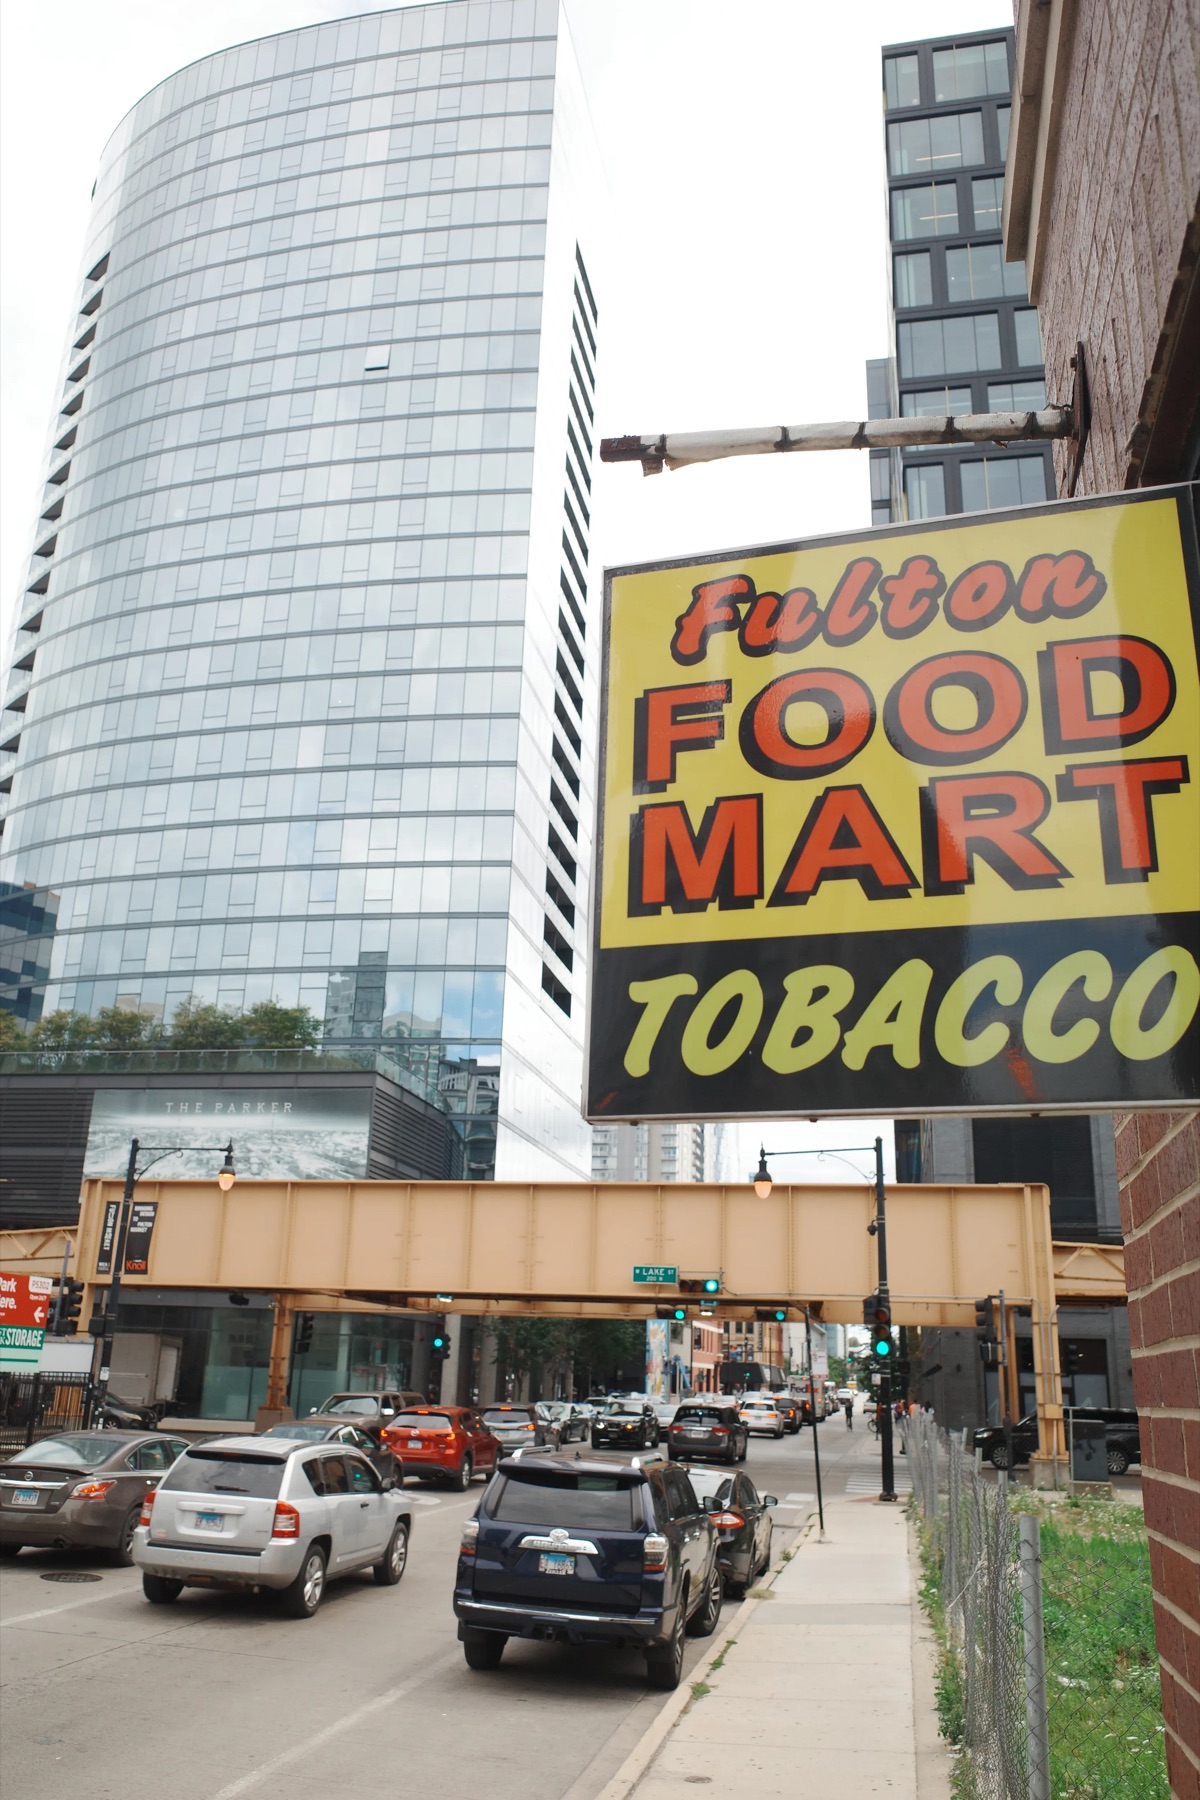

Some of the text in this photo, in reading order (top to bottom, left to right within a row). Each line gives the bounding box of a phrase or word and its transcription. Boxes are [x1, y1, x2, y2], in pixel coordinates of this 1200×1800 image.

[671, 550, 1107, 666] Fulton
[633, 635, 1176, 794] FOOD
[627, 755, 1190, 918] MART
[624, 945, 1200, 1078] TOBACCO
[165, 1102, 293, 1113] THE PARKER
[126, 1261, 146, 1270] Knoll
[642, 1268, 665, 1276] LAKE
[0, 1296, 17, 1309] ere.
[6, 1328, 43, 1347] STORAGE
